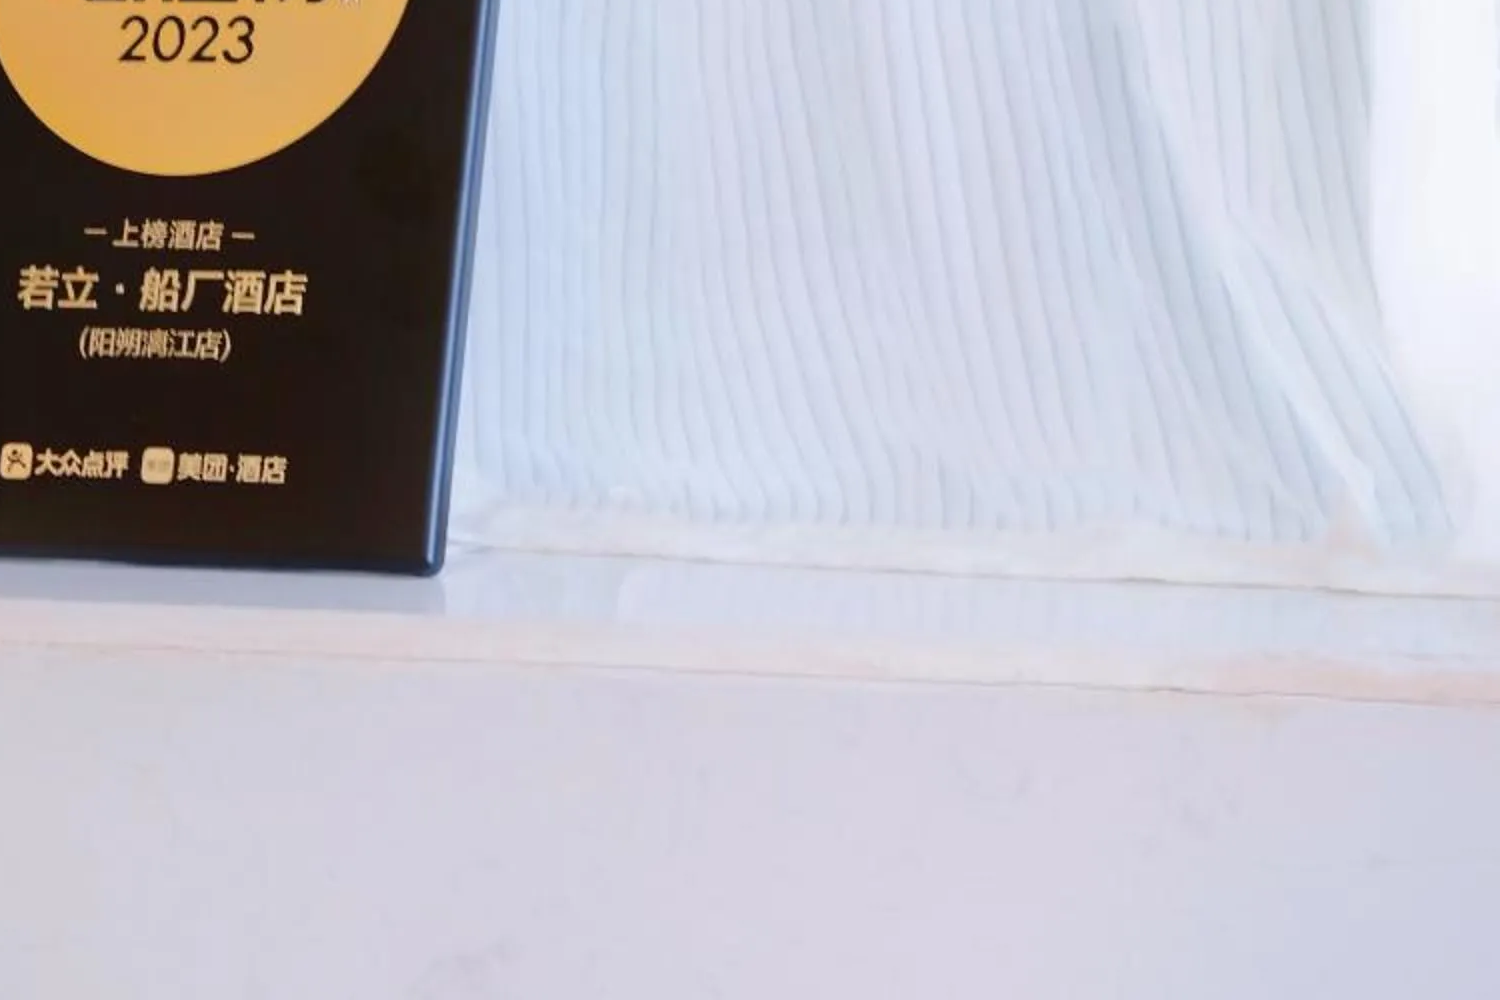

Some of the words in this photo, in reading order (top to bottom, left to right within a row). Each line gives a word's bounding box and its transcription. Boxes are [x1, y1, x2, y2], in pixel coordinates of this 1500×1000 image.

[118, 15, 256, 64] 2023
[112, 217, 225, 251] 上榜酒店
[34, 447, 130, 480] 大众点评
